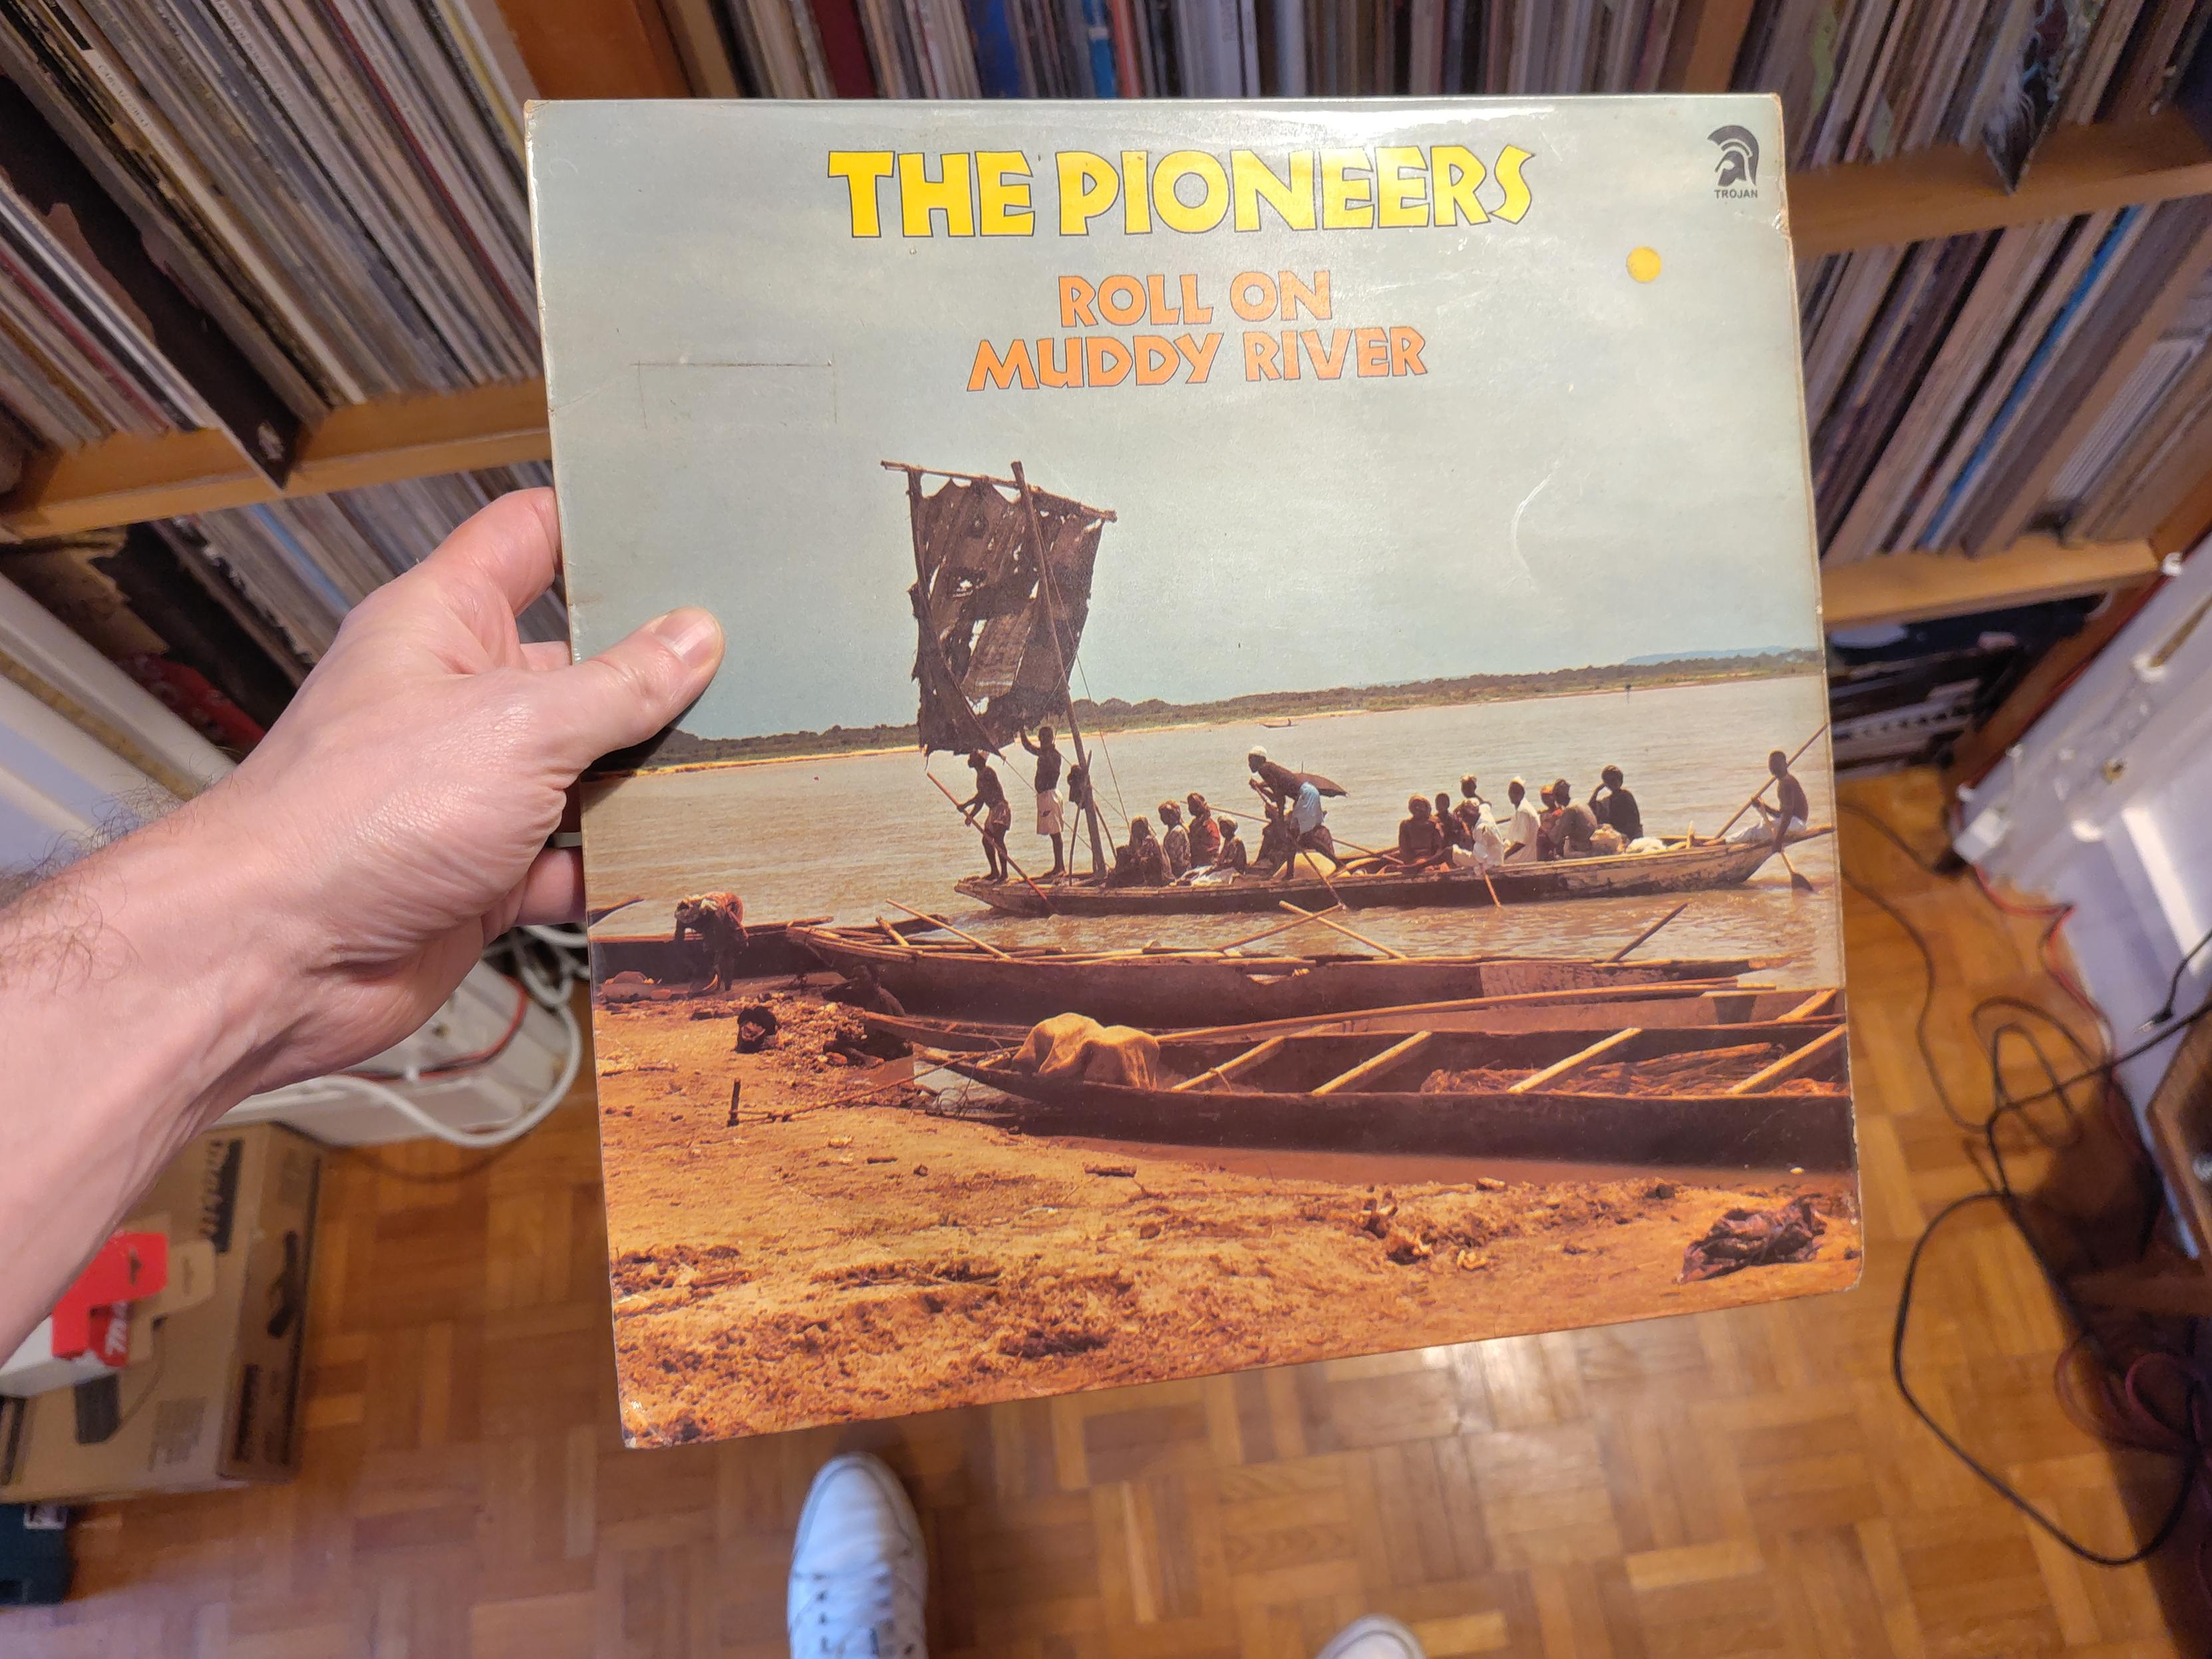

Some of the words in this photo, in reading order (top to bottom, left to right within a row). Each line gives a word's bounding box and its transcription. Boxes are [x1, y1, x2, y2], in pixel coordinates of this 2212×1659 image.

[827, 150, 1036, 238] THE
[1056, 145, 1535, 235] PIONEERS
[1714, 188, 1758, 199] TROJAN
[1058, 273, 1213, 329] ROLL
[1229, 269, 1332, 323] ON
[965, 331, 1225, 392] MUDDY
[1242, 326, 1429, 382] RIVER
